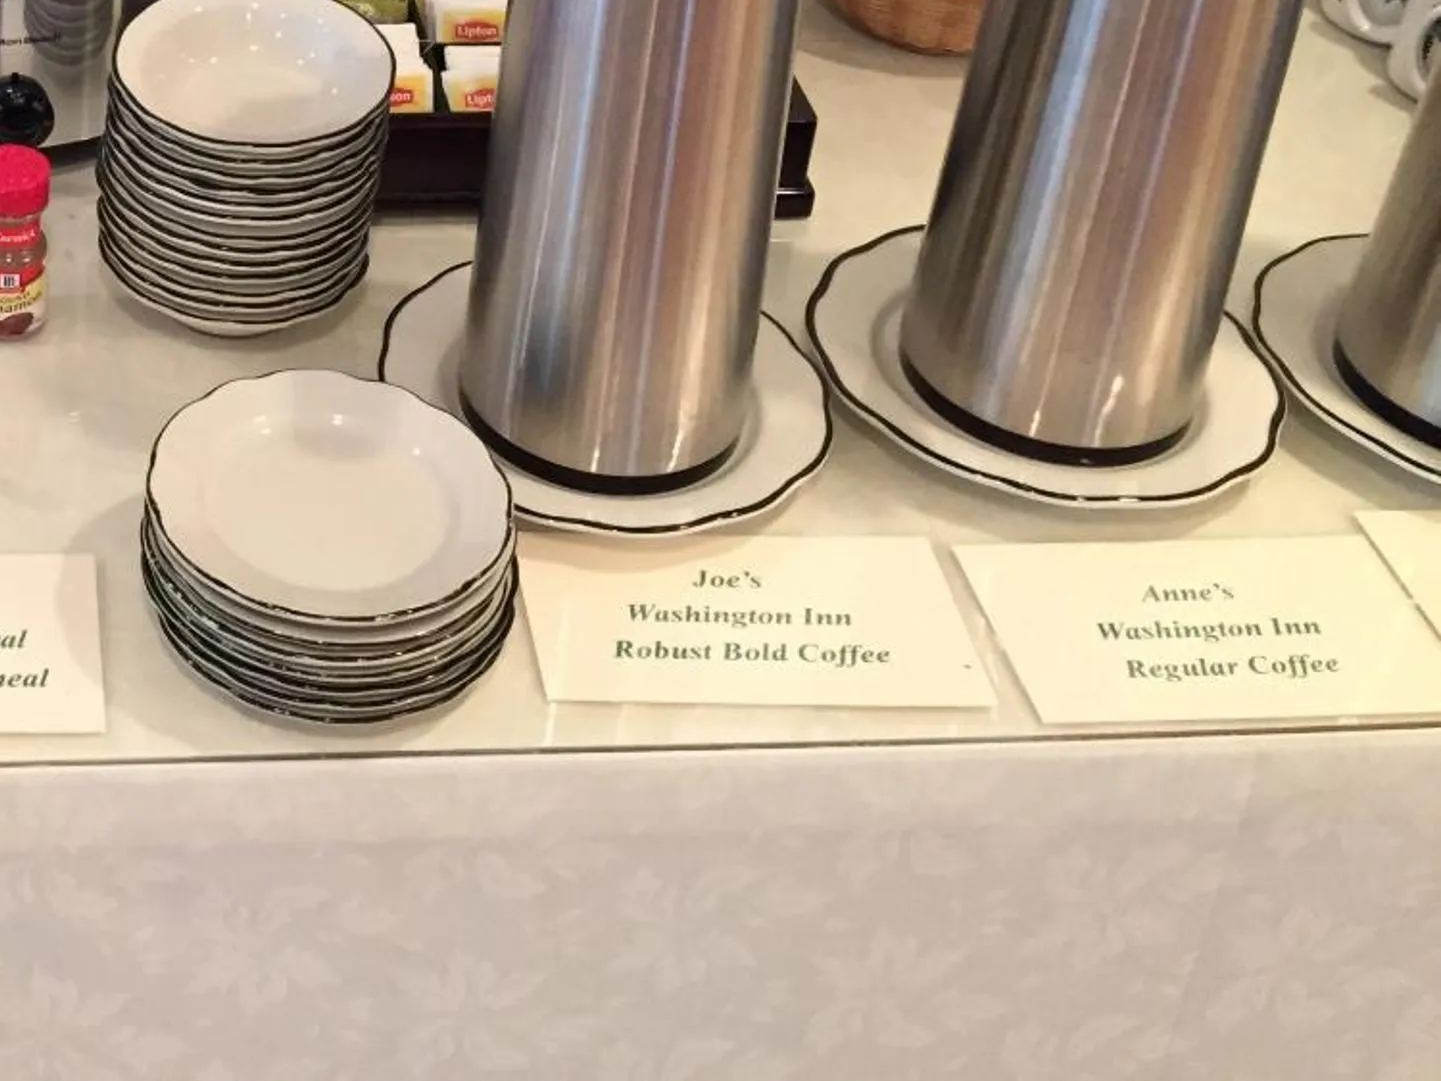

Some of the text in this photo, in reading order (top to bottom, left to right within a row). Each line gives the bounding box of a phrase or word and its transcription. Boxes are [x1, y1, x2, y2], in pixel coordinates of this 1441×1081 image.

[457, 26, 497, 38] Lipton
[466, 93, 495, 108] Lipt
[692, 569, 762, 590] Joe's
[1141, 582, 1235, 604] Anne's
[627, 603, 853, 629] Washington Inn
[1096, 617, 1323, 642] Washington Inn
[614, 639, 892, 669] Robust Bold Coffee
[1125, 654, 1340, 682] Regular Coffee
